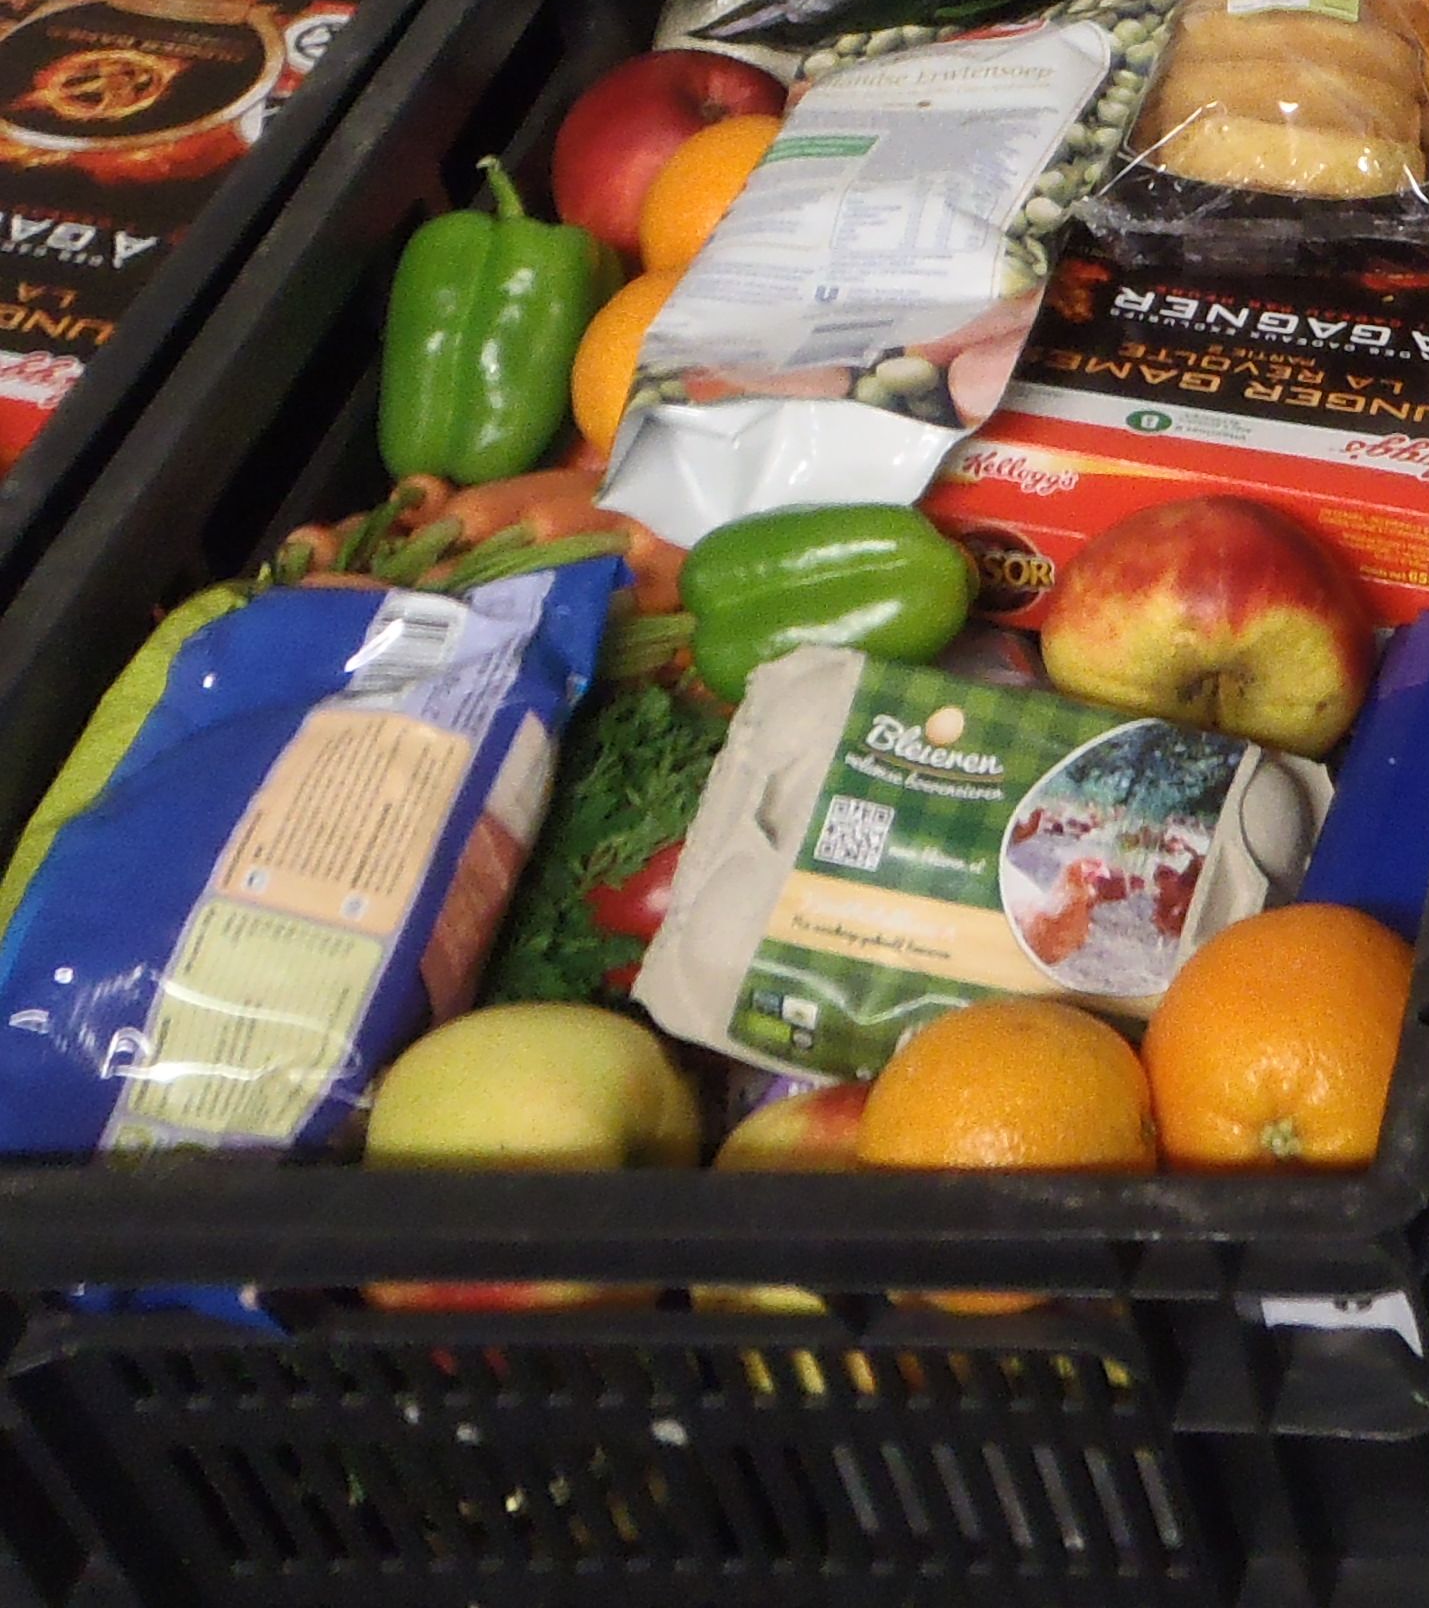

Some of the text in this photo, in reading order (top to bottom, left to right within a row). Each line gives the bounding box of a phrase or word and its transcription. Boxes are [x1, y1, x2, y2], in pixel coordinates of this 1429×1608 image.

[1113, 285, 1392, 348] GAGNER
[1348, 374, 1404, 394] LA
[962, 449, 1081, 495] Kellogg's
[979, 550, 1055, 588] SOR
